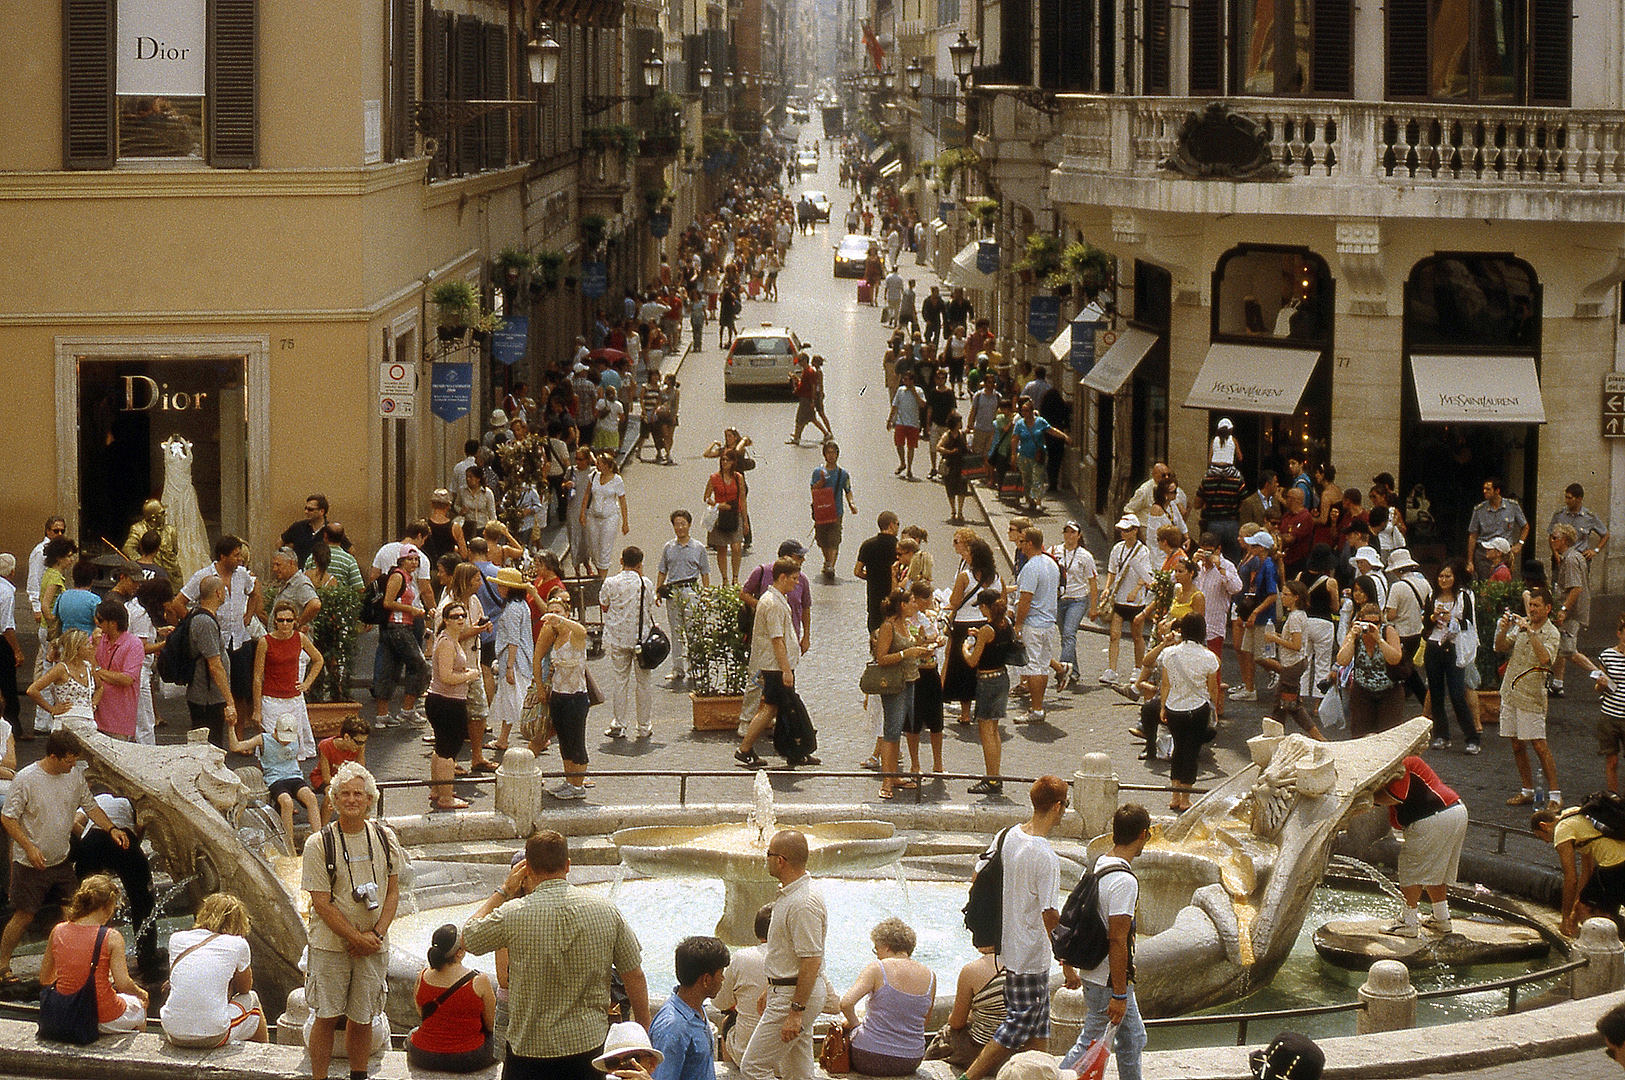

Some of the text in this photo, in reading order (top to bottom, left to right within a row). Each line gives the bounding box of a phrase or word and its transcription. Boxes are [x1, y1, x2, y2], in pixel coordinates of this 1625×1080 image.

[134, 36, 190, 60] Dior
[280, 338, 295, 350] 75
[1337, 357, 1351, 368] 77
[120, 375, 207, 411] Dior
